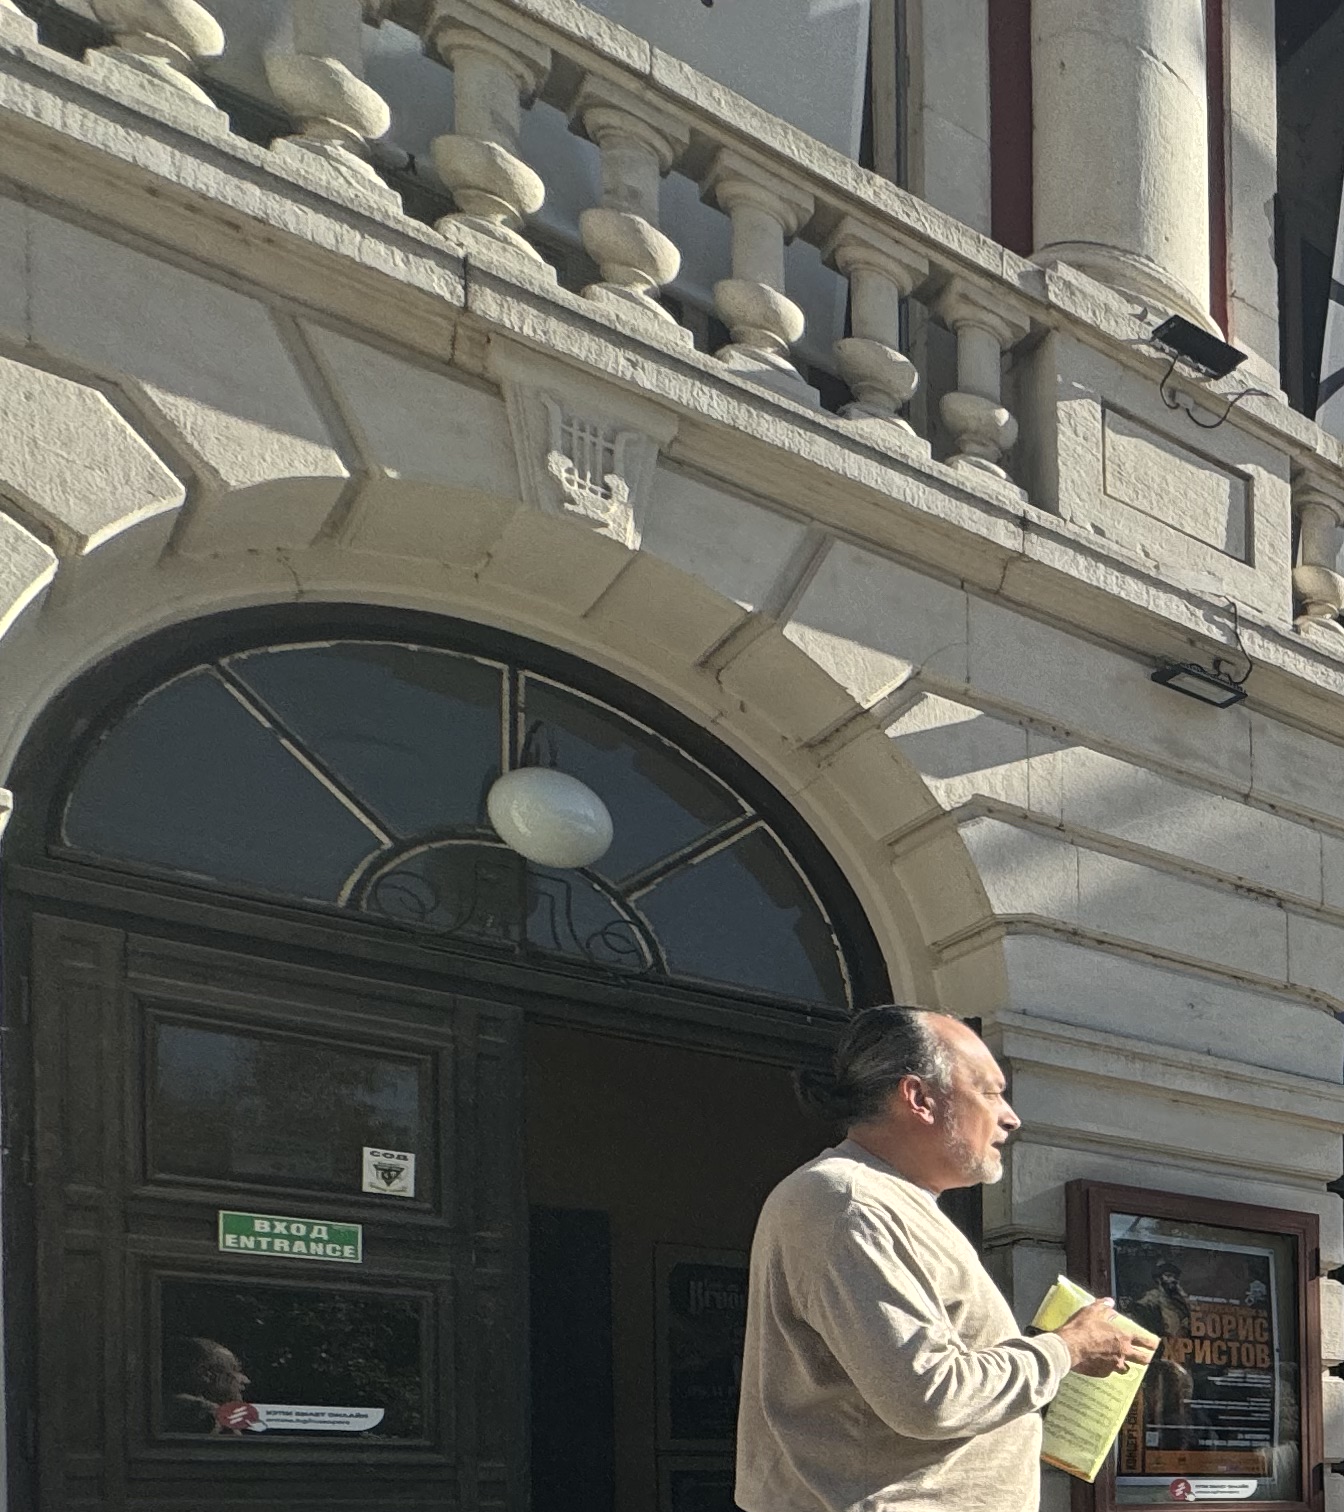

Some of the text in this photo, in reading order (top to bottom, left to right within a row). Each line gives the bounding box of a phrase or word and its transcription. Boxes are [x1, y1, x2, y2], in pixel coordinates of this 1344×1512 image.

[253, 1218, 330, 1241] ВХОД
[225, 1233, 357, 1259] ENTRANCE
[1190, 1311, 1269, 1343] БОРИС
[1161, 1336, 1271, 1369] ХРИСТОВ
